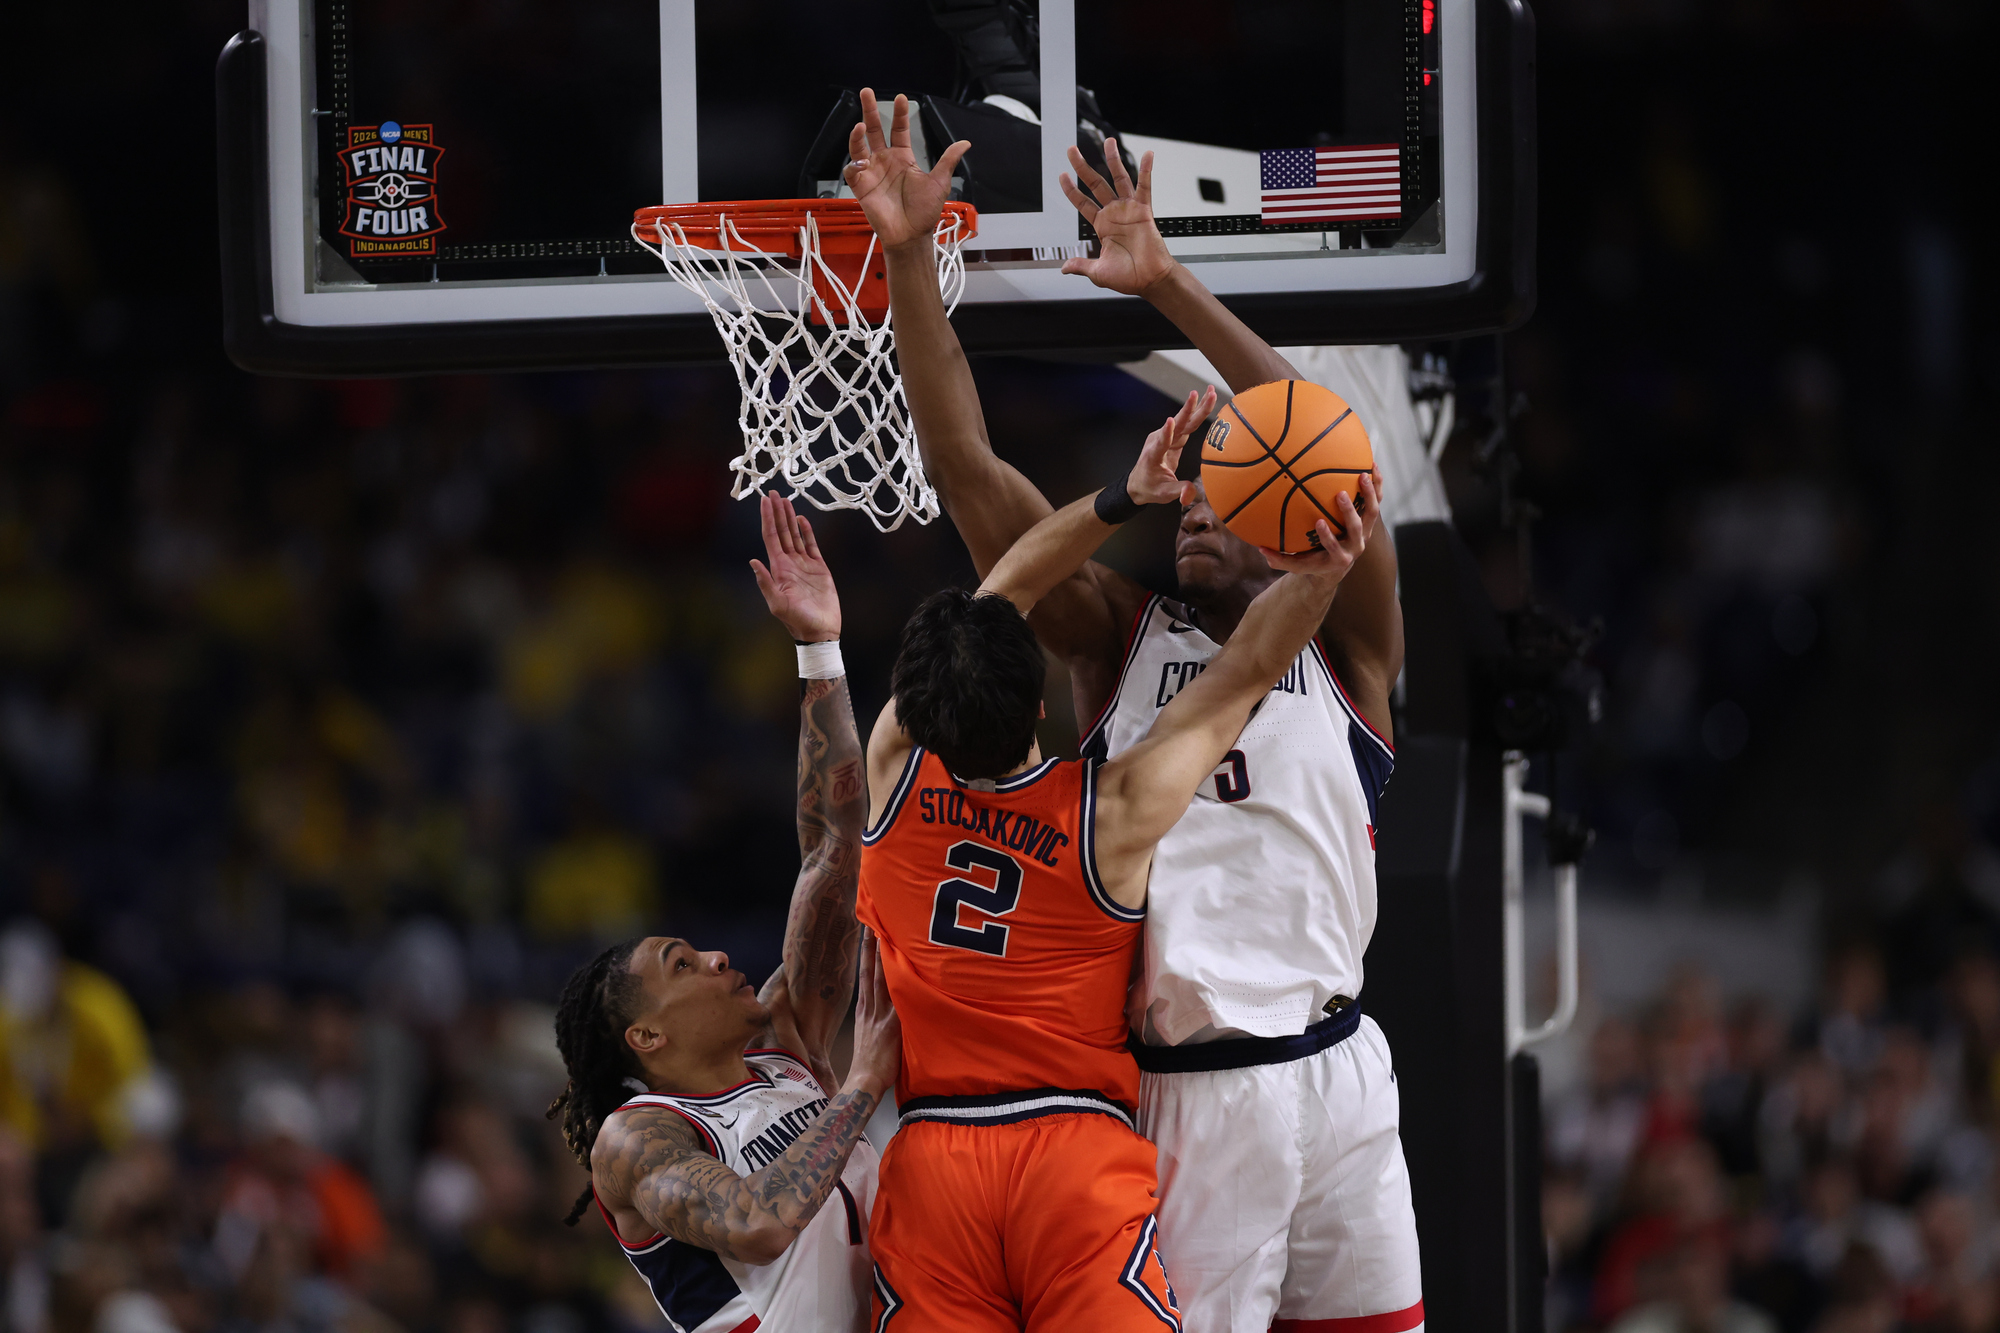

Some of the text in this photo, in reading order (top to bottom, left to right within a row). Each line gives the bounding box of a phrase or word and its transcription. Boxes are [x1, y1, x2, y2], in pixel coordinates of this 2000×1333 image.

[353, 130, 428, 143] 2026 MEN'S
[351, 146, 428, 177] FINAL
[355, 206, 430, 235] FOUR
[357, 239, 429, 252] INDIANAPOLIS
[920, 787, 1069, 867] STOJAKOVIC
[928, 839, 1025, 958] 2
